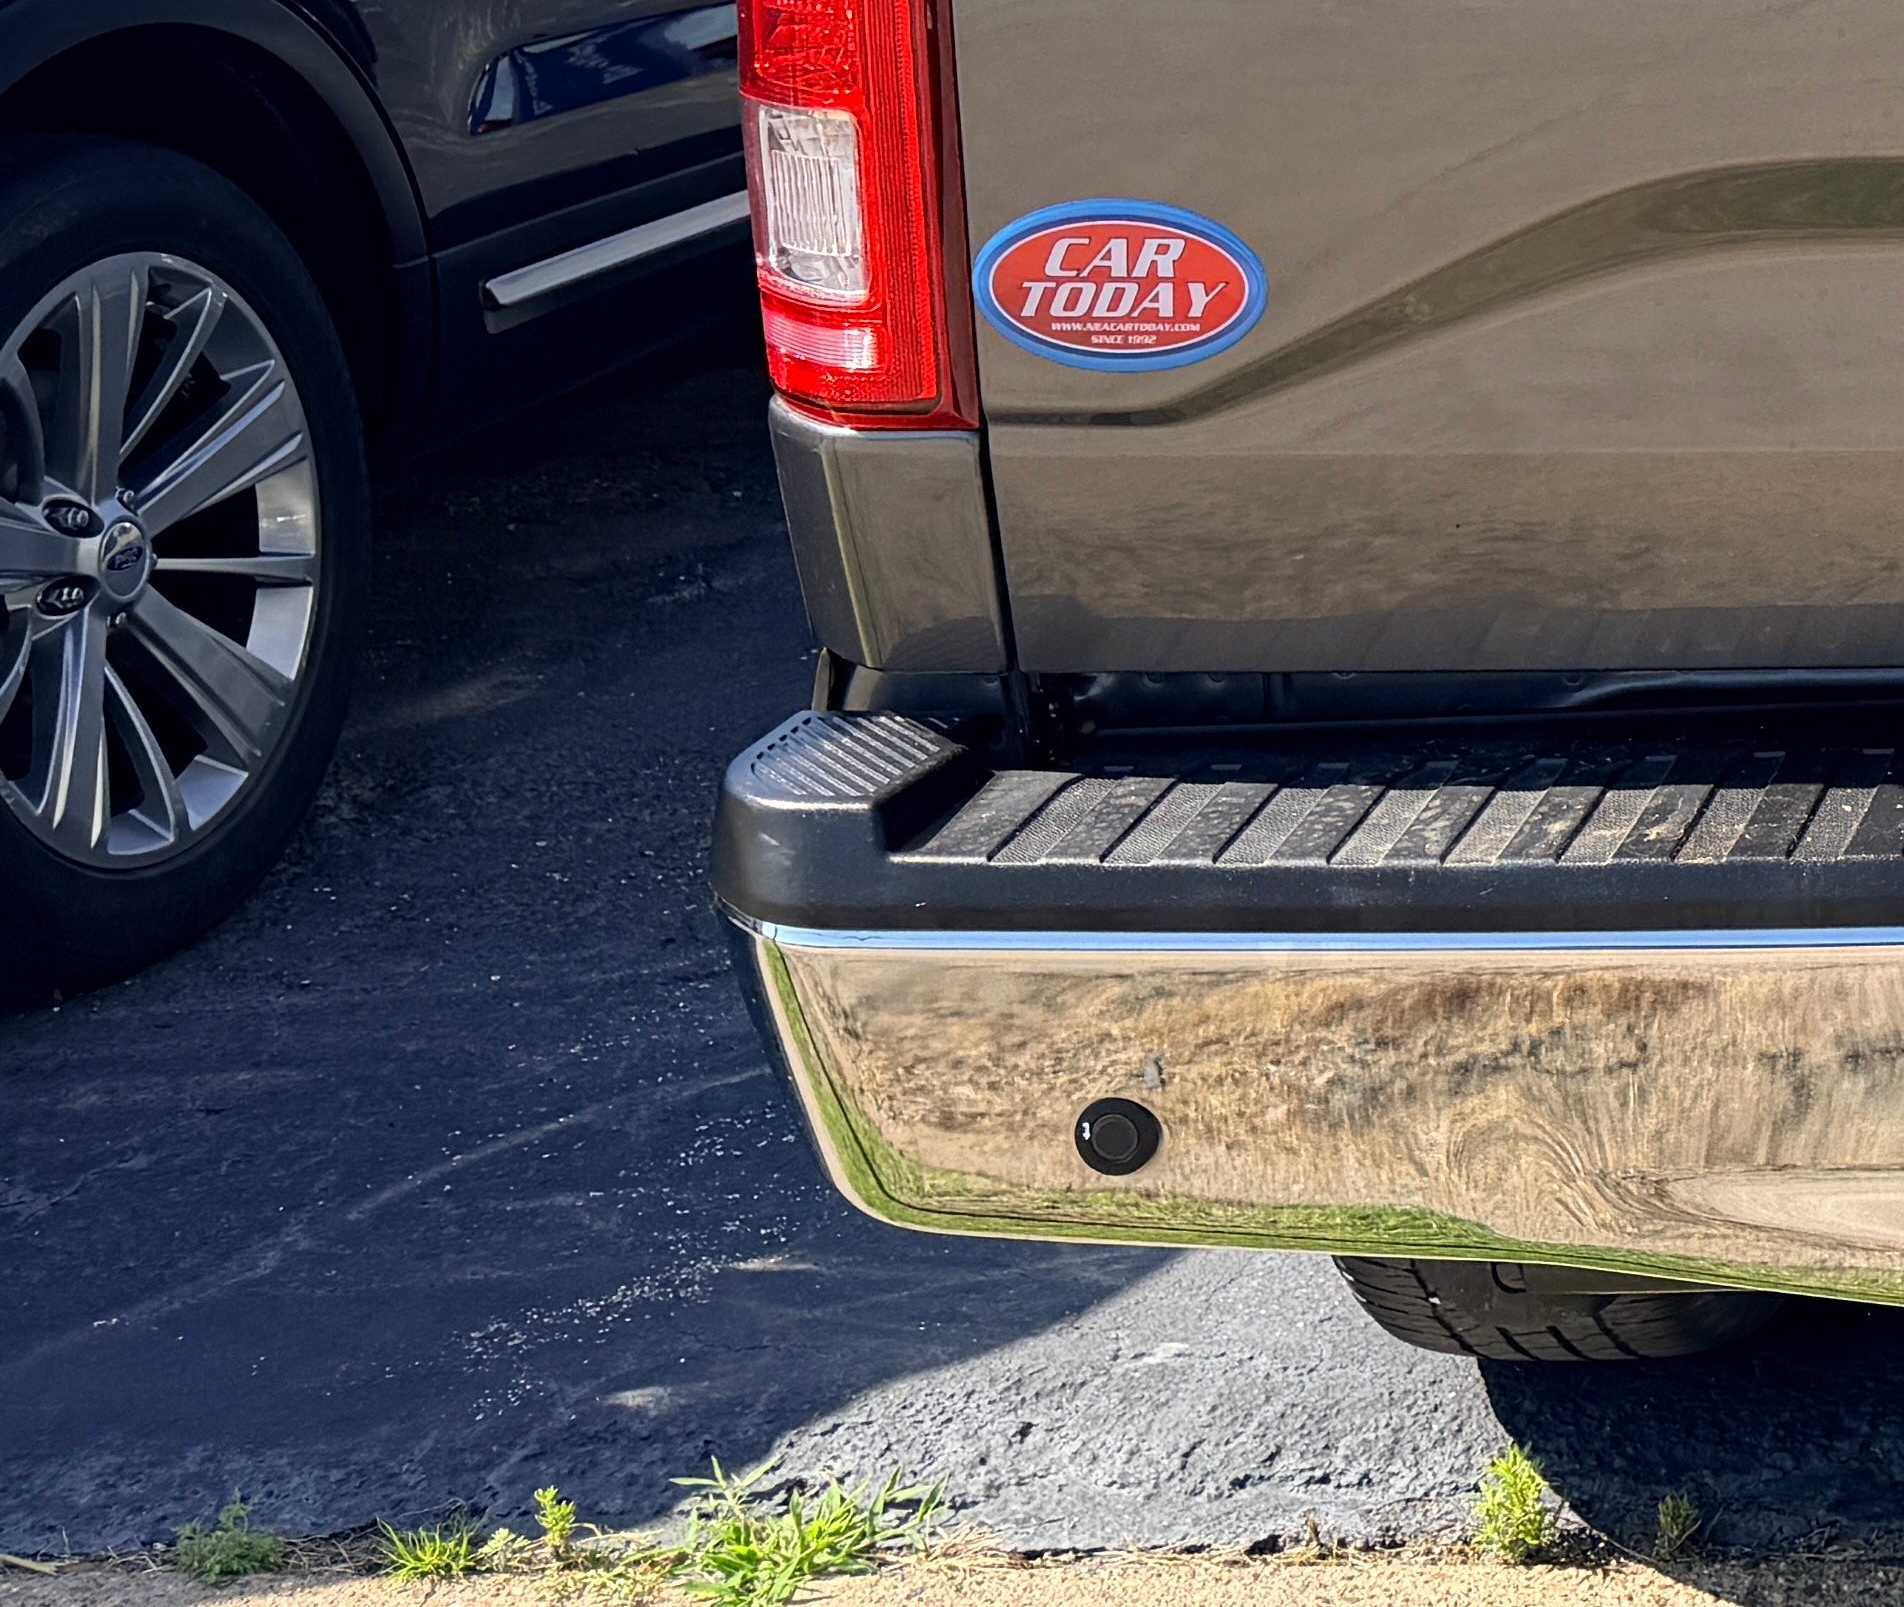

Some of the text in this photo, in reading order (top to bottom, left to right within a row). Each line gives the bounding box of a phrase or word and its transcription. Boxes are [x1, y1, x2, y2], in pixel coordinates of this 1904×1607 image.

[1045, 238, 1185, 278] CAR
[1021, 282, 1228, 318] TODAY
[1091, 334, 1125, 344] SINCE
